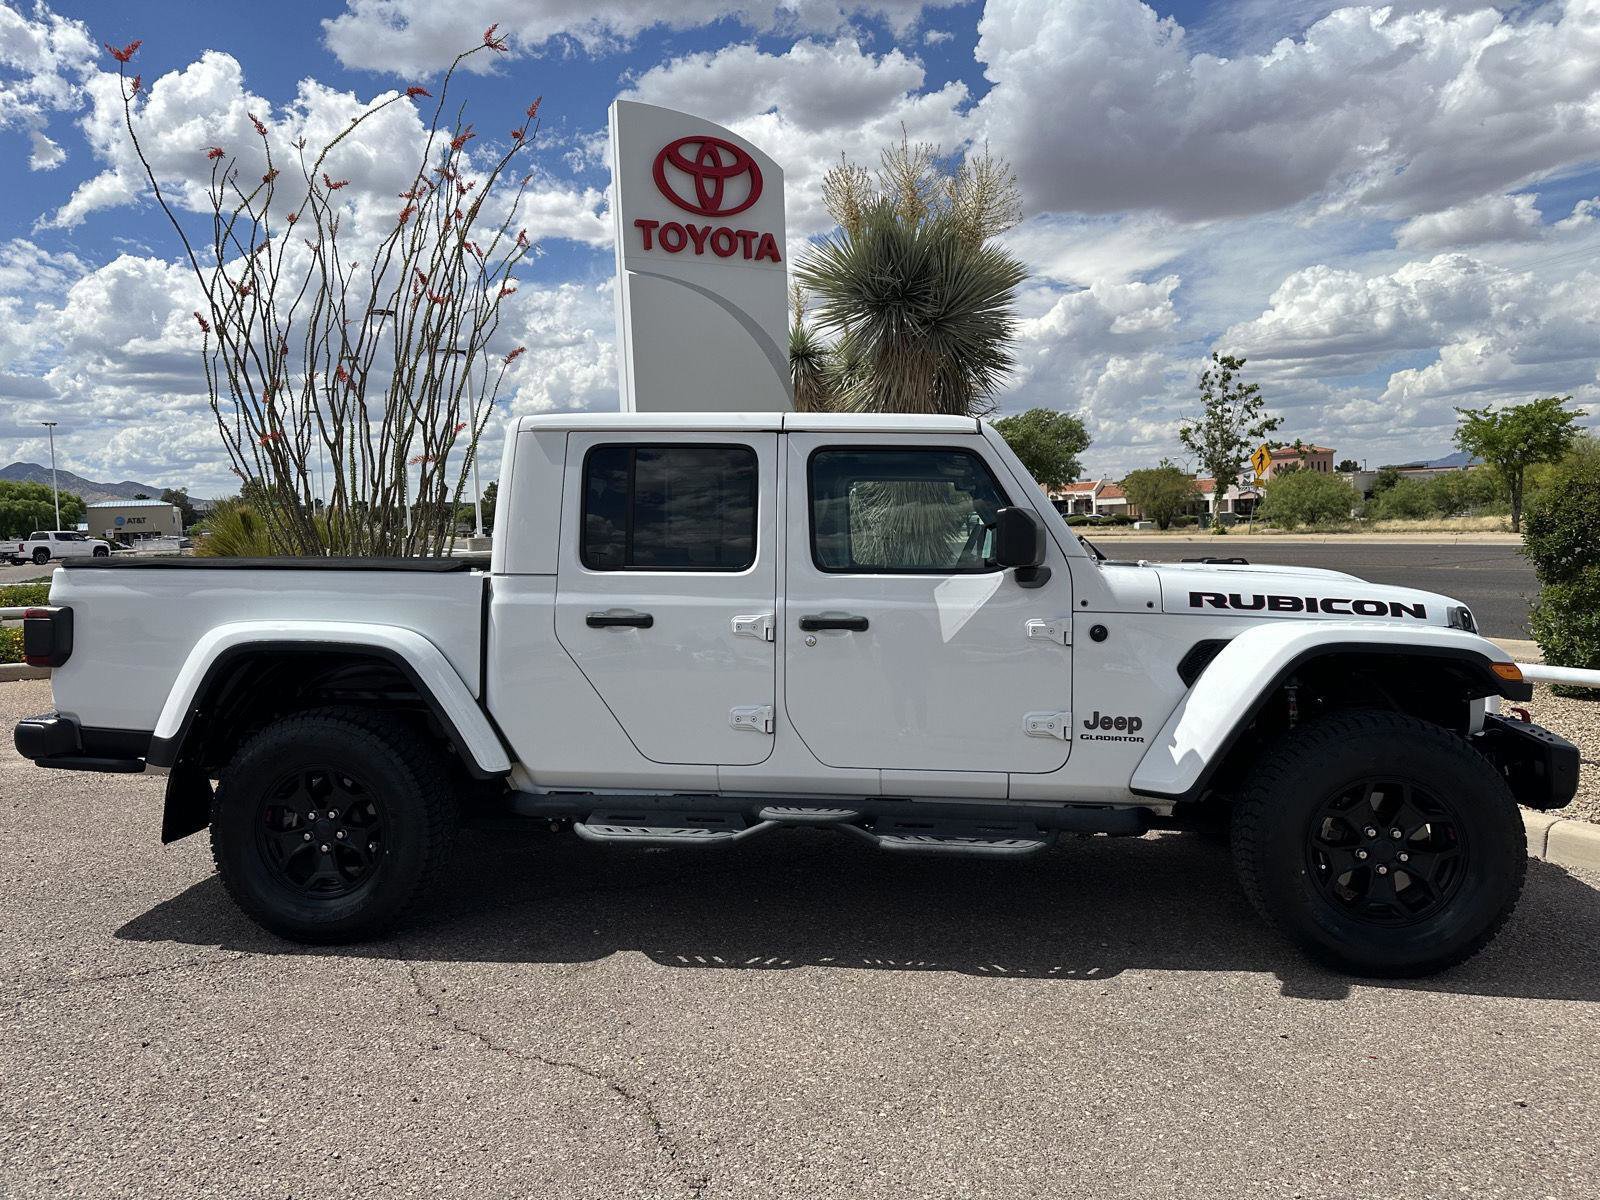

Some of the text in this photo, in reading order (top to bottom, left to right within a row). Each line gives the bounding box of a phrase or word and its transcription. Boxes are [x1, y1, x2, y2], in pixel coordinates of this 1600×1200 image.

[634, 219, 781, 262] TOYOTA
[1189, 591, 1427, 619] RUBICON
[1083, 711, 1143, 734] Jeep
[1080, 734, 1145, 743] GLADIATOR
